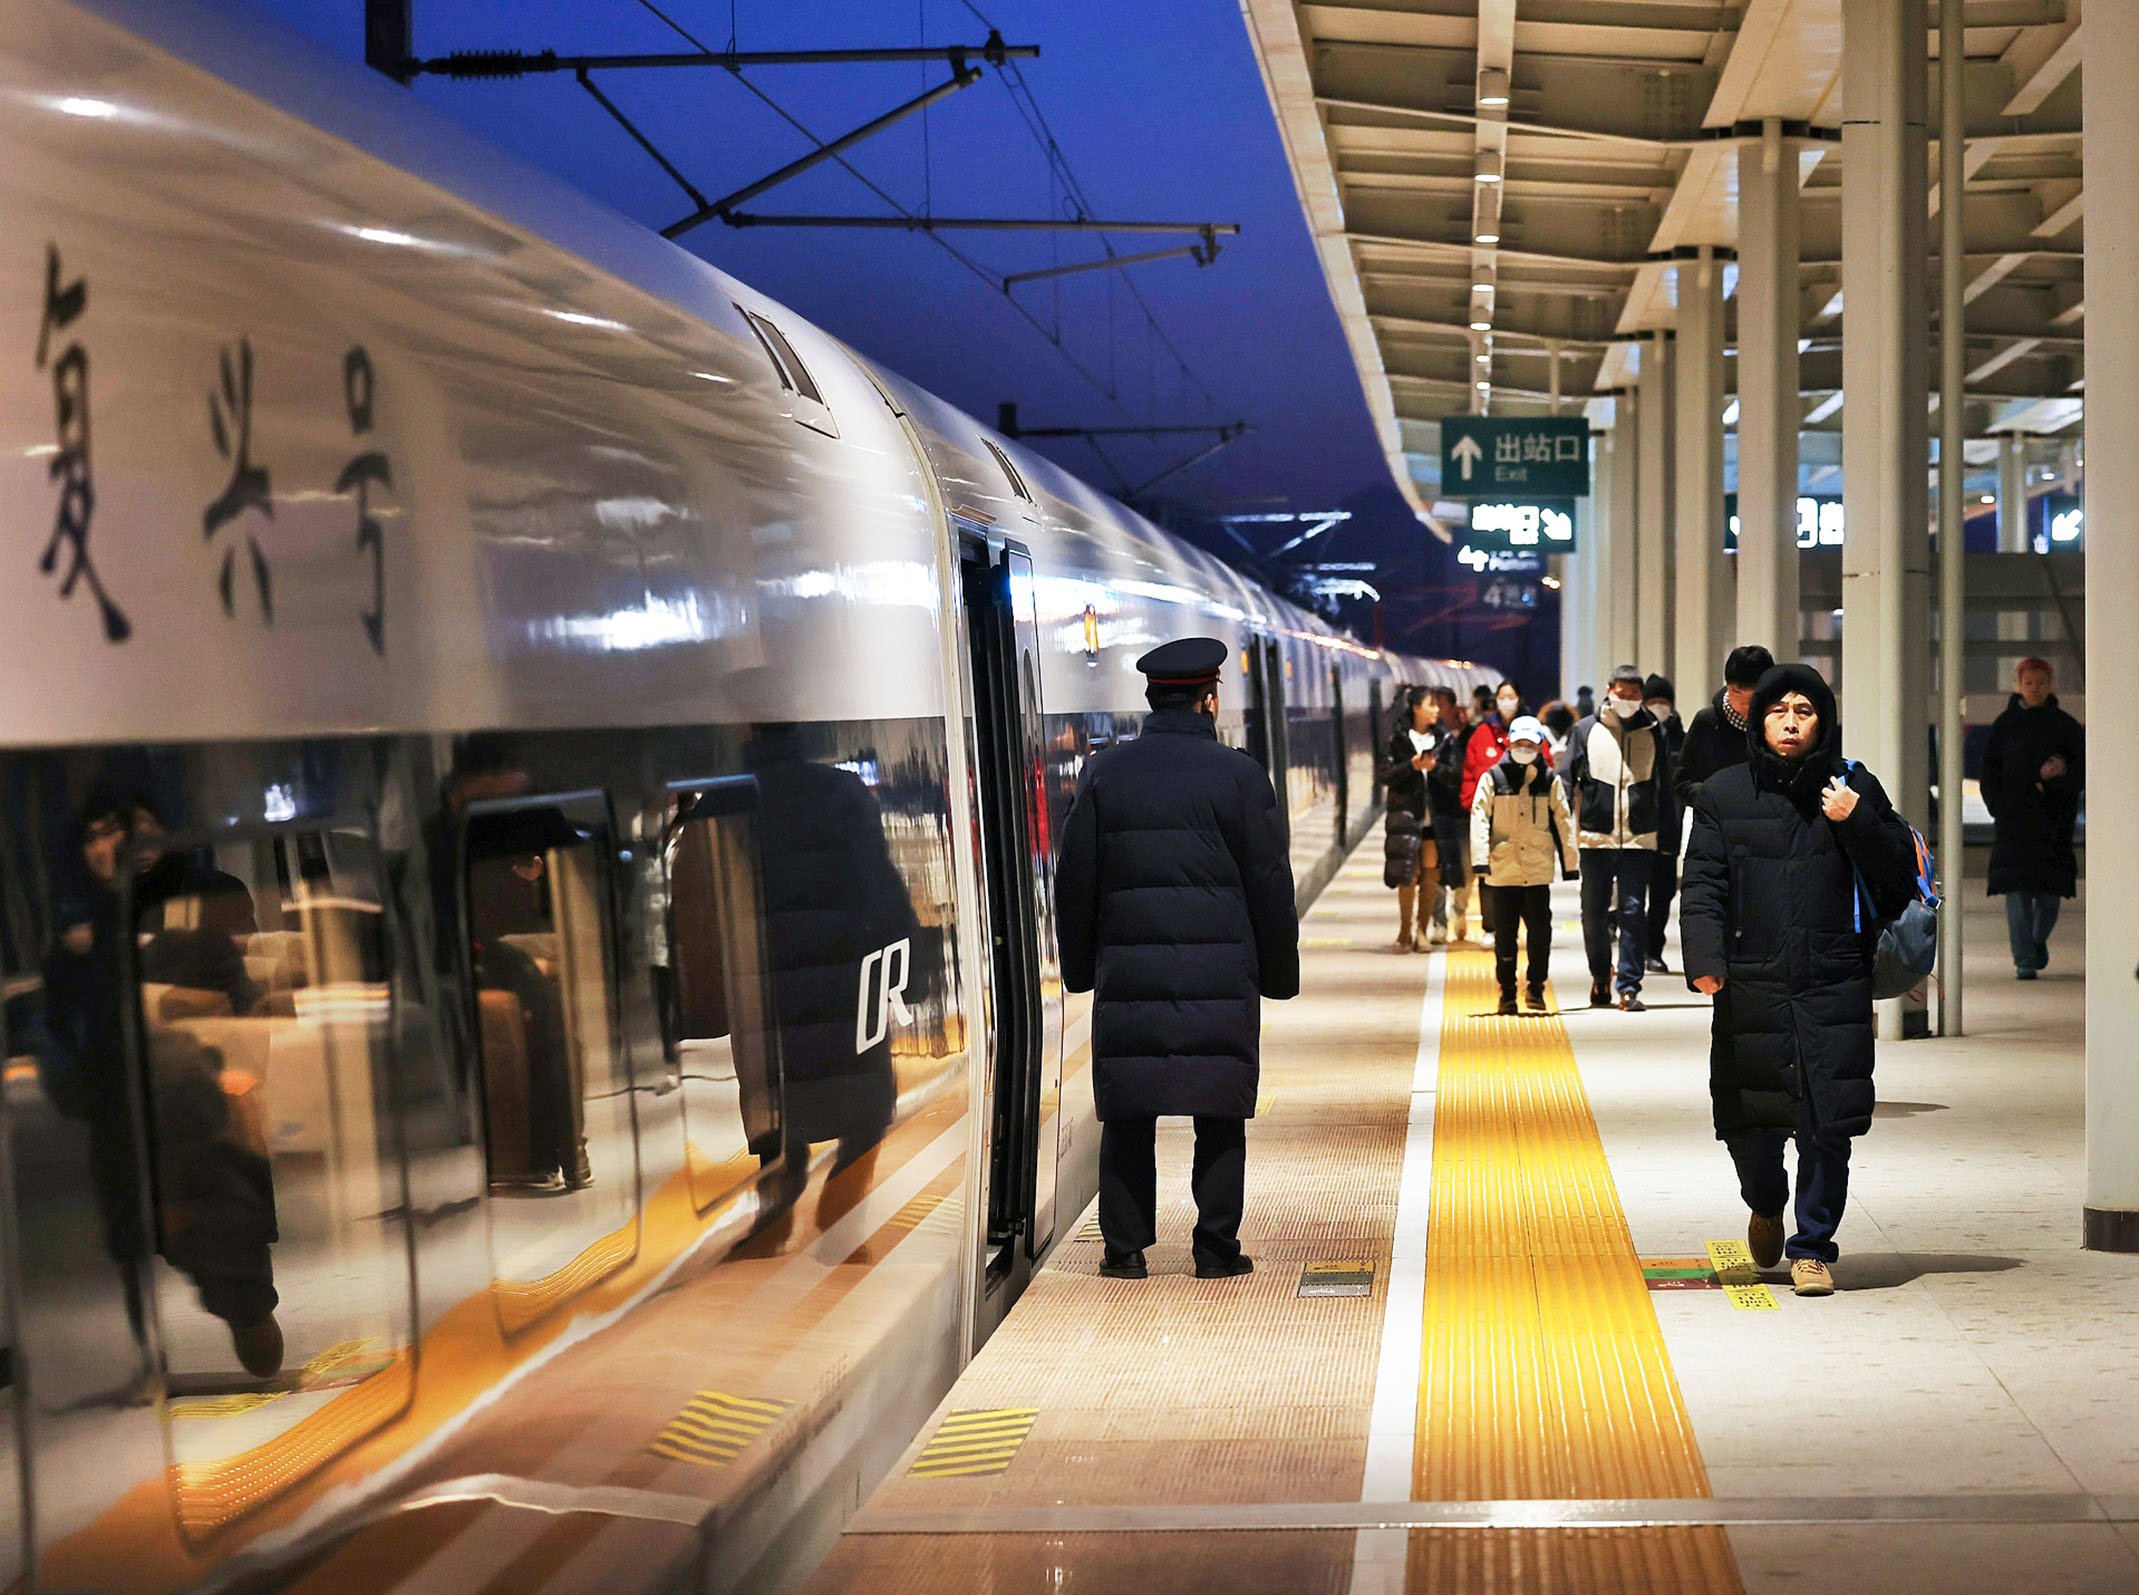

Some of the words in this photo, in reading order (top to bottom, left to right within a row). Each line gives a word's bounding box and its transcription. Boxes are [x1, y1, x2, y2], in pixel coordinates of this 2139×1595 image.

[1496, 432, 1579, 462] 出站口
[1496, 466, 1528, 481] Exit
[856, 937, 914, 1055] CR
